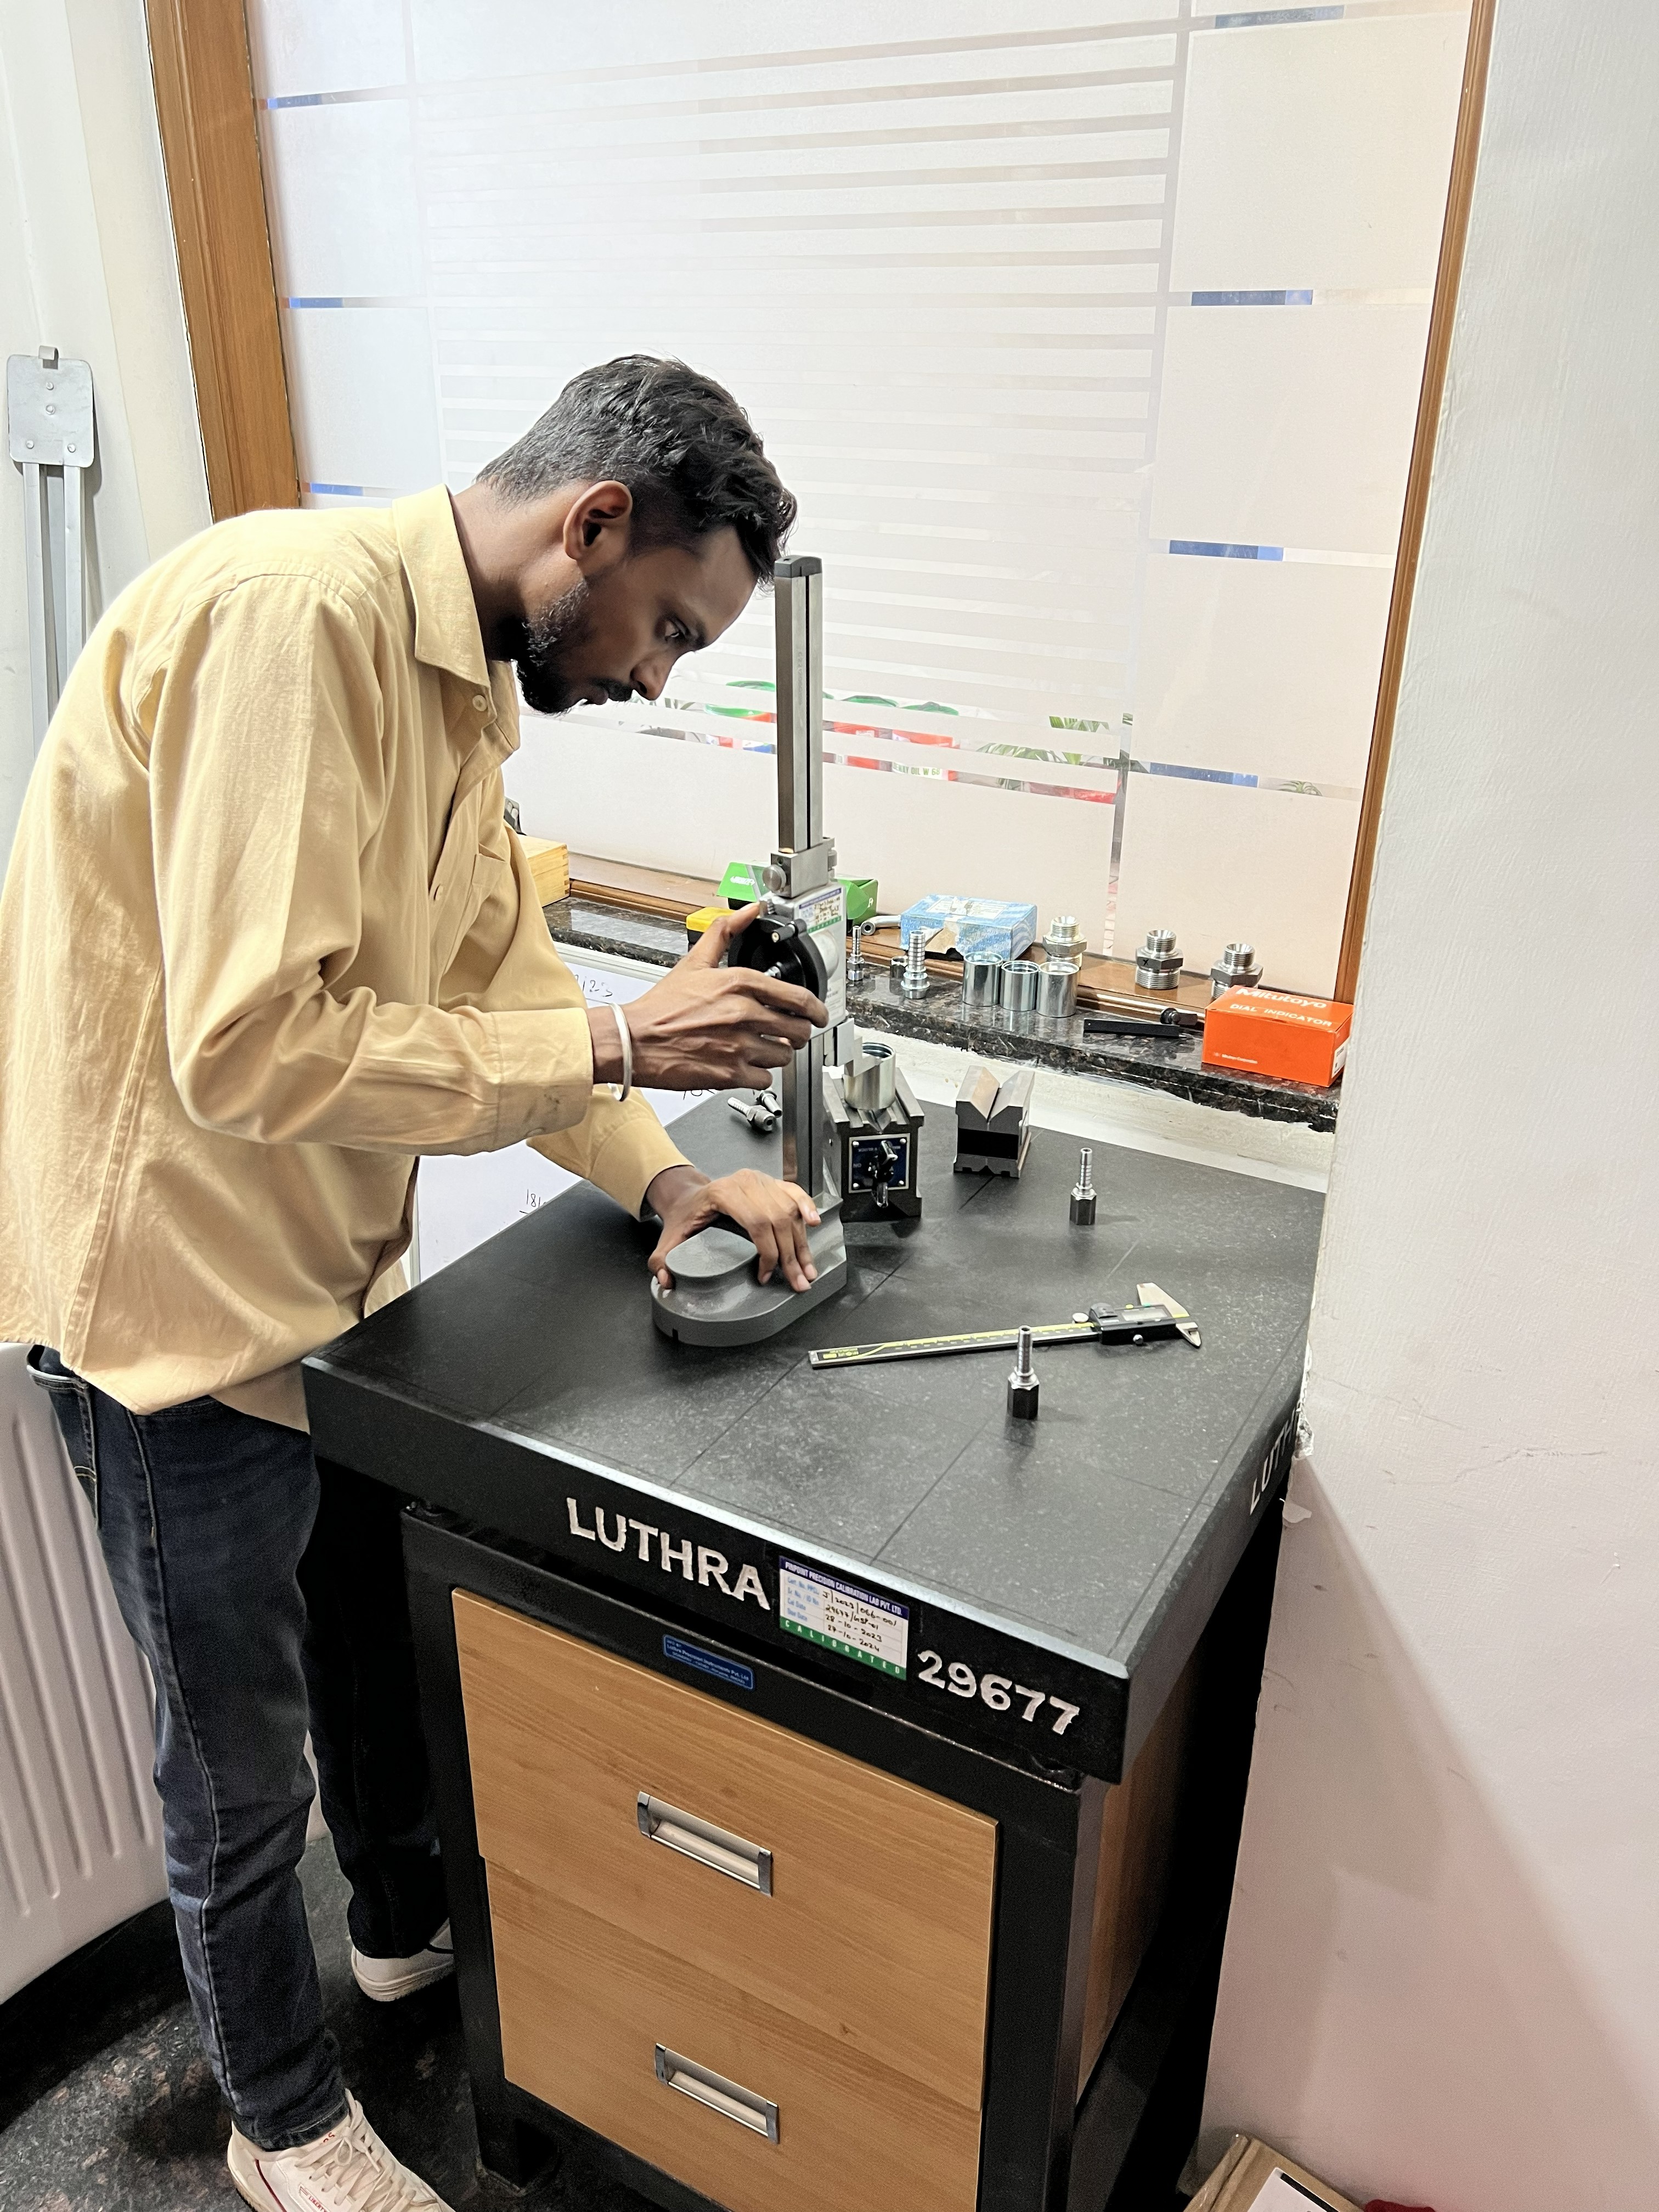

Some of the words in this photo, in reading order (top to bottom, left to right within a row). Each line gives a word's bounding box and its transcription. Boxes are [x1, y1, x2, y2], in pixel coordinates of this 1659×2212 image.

[911, 767, 921, 775] OIL
[1235, 988, 1327, 1008] Mitutoyo
[1230, 1004, 1257, 1012] DIAL
[1264, 1009, 1332, 1026] INDICATOR
[566, 1497, 770, 1611] LUTHRA
[836, 1582, 868, 1601] CALIBRATION
[869, 1595, 879, 1606] LAB
[917, 1650, 1080, 1735] 29677
